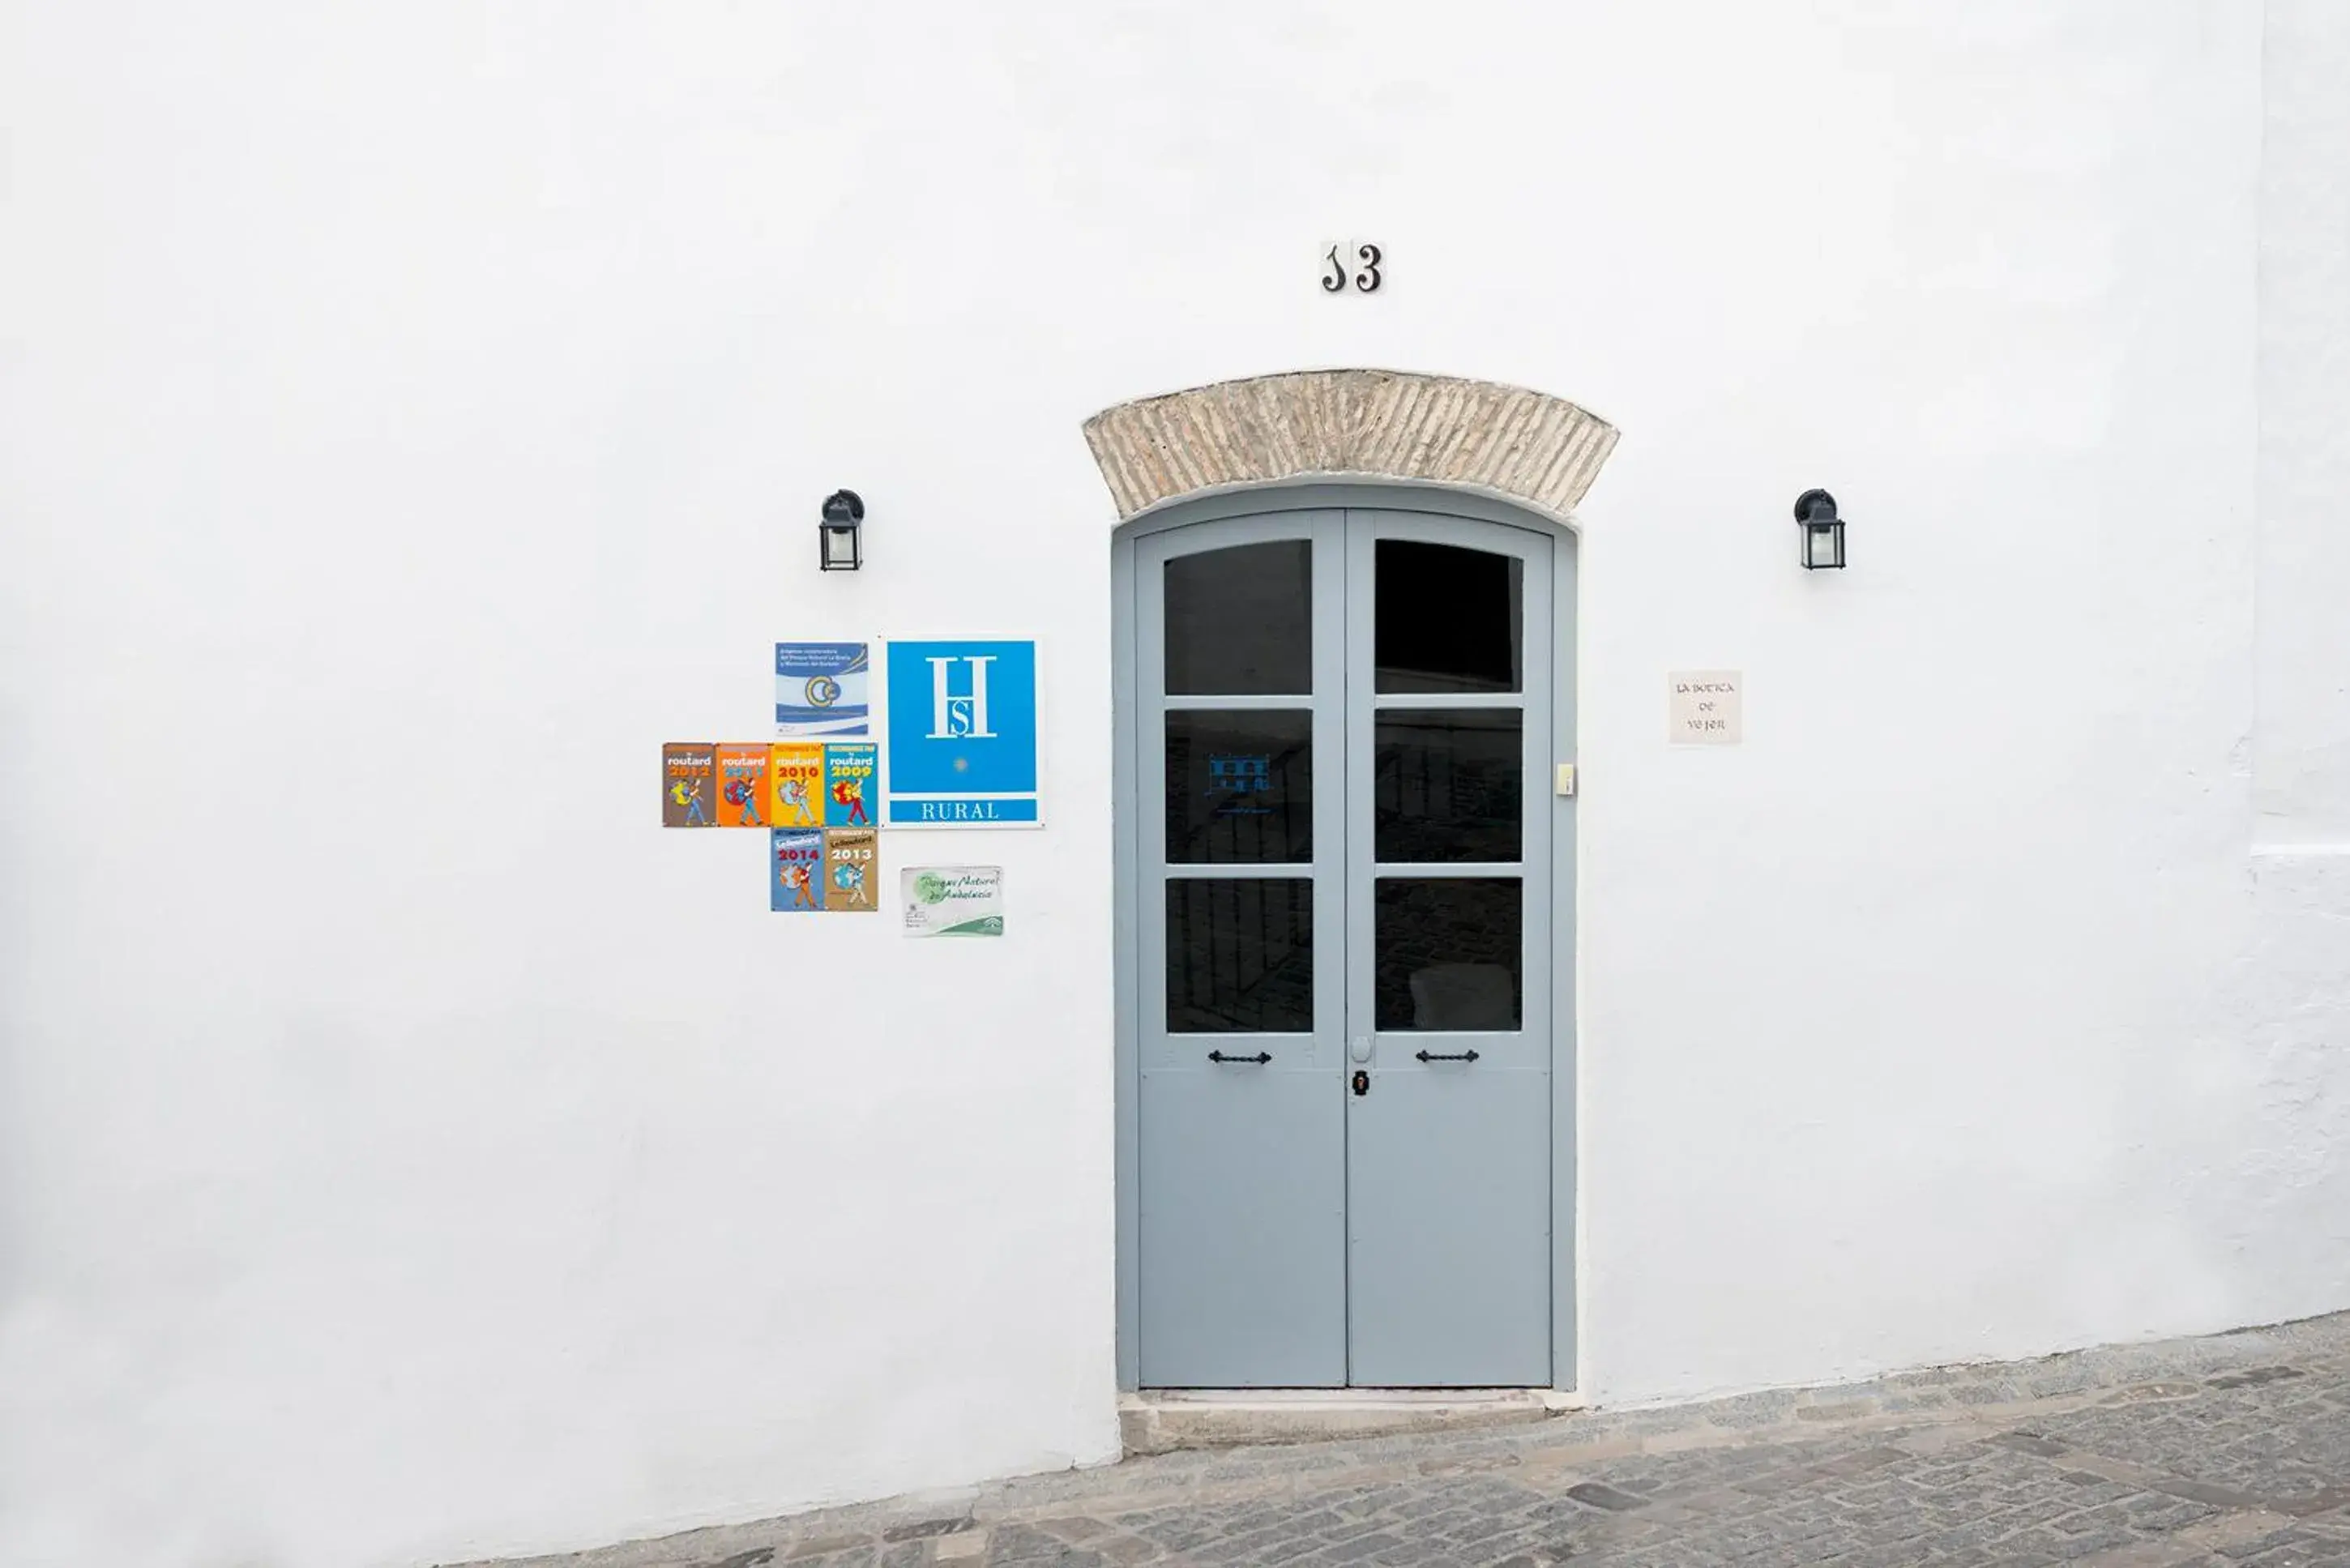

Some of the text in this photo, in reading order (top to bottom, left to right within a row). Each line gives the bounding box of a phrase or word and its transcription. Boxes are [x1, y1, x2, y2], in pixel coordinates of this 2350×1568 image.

[667, 756, 711, 766] routard
[722, 757, 766, 767] routard
[776, 757, 819, 767] routard
[830, 756, 874, 766] routard
[669, 766, 711, 777] 2012
[778, 767, 818, 777] 2010
[831, 766, 872, 777] 2009
[921, 802, 998, 819] RURAL
[778, 849, 818, 861] 2014
[831, 848, 873, 860] 2013
